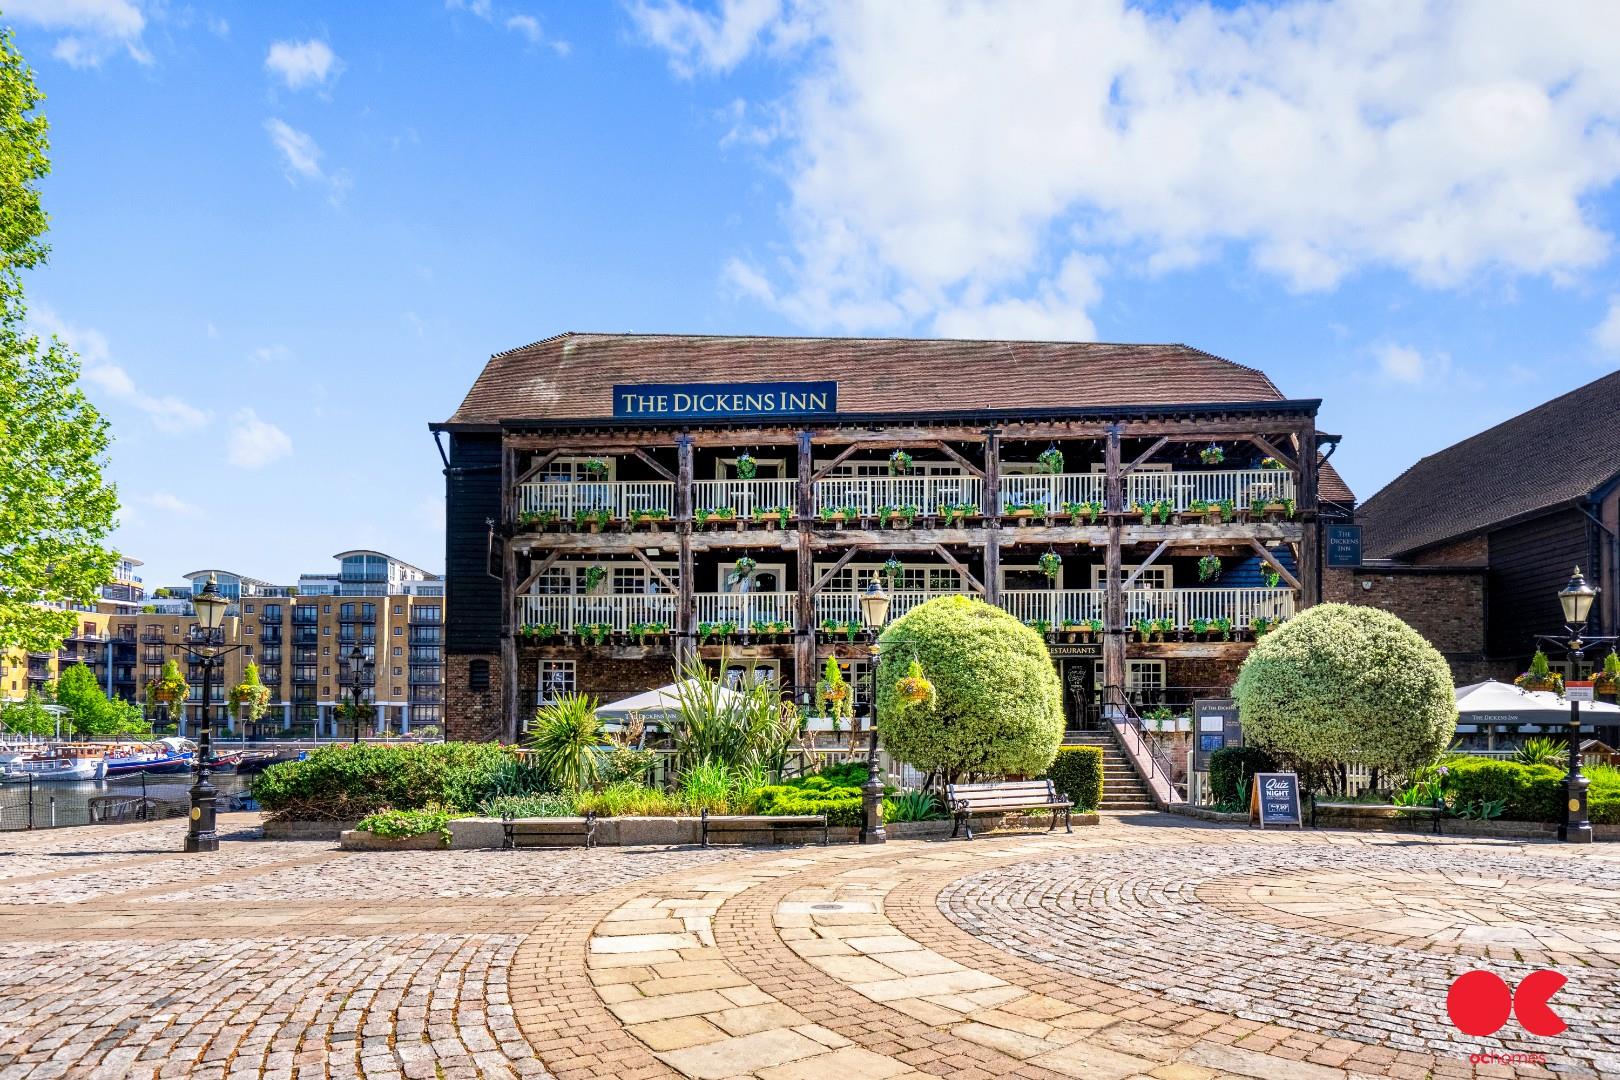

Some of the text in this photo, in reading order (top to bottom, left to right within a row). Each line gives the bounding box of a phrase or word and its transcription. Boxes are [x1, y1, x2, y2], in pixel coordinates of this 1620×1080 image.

[621, 392, 827, 412] THE DICKENS INN
[1265, 778, 1289, 790] Quiz
